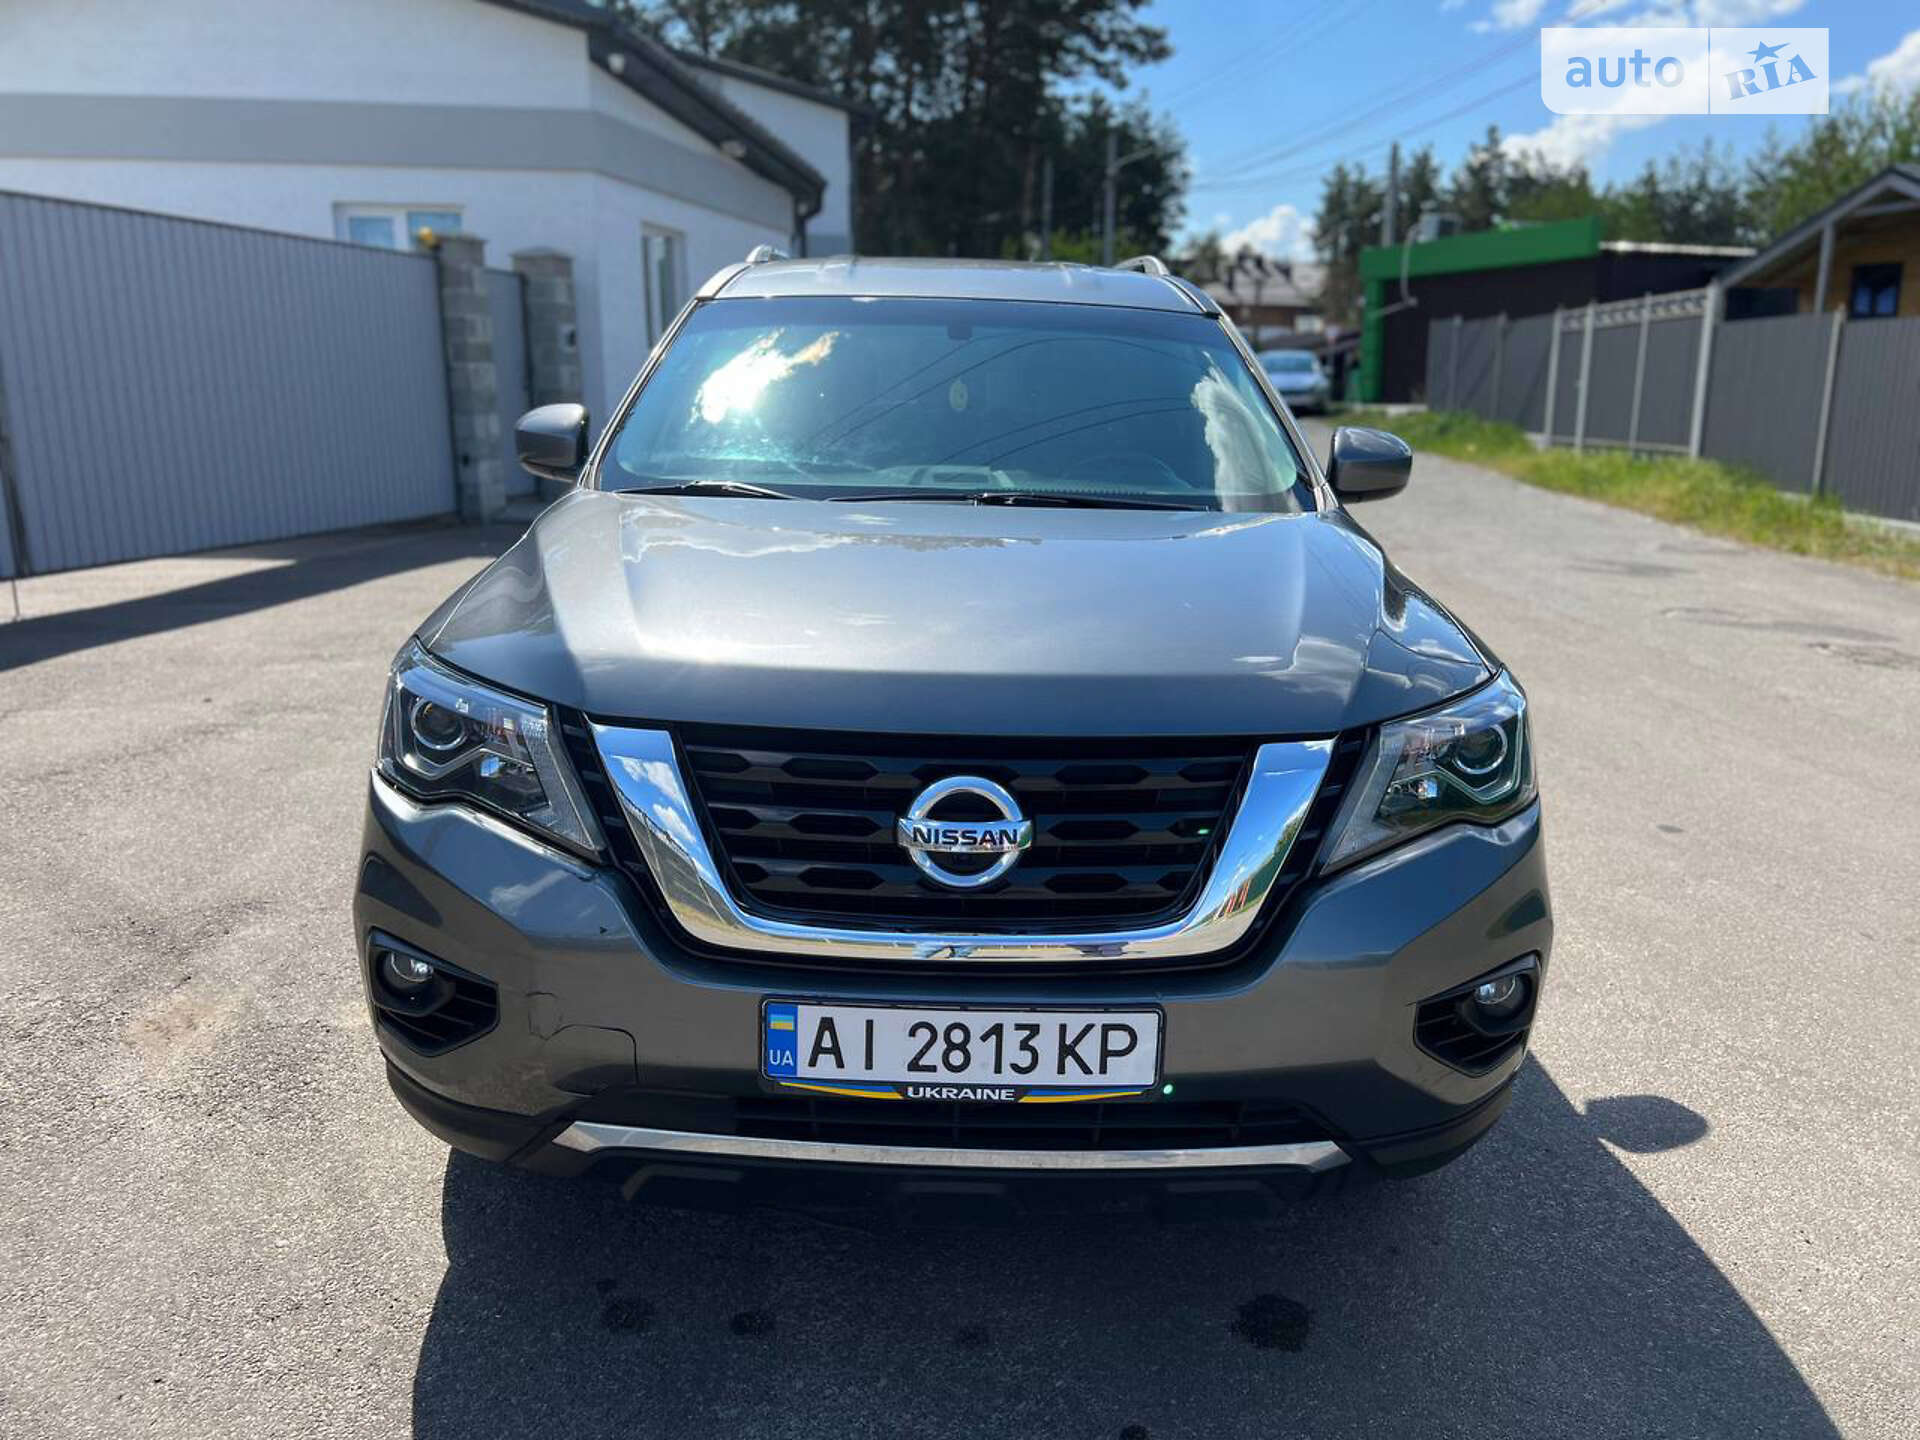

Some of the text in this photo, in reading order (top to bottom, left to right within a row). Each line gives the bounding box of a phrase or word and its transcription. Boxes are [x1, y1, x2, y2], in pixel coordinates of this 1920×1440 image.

[912, 827, 1018, 846] NISSAN
[906, 1020, 1040, 1075] 2813
[1056, 1022, 1139, 1075] KP
[769, 1048, 794, 1067] UA
[906, 1085, 1016, 1101] UKRAINE
